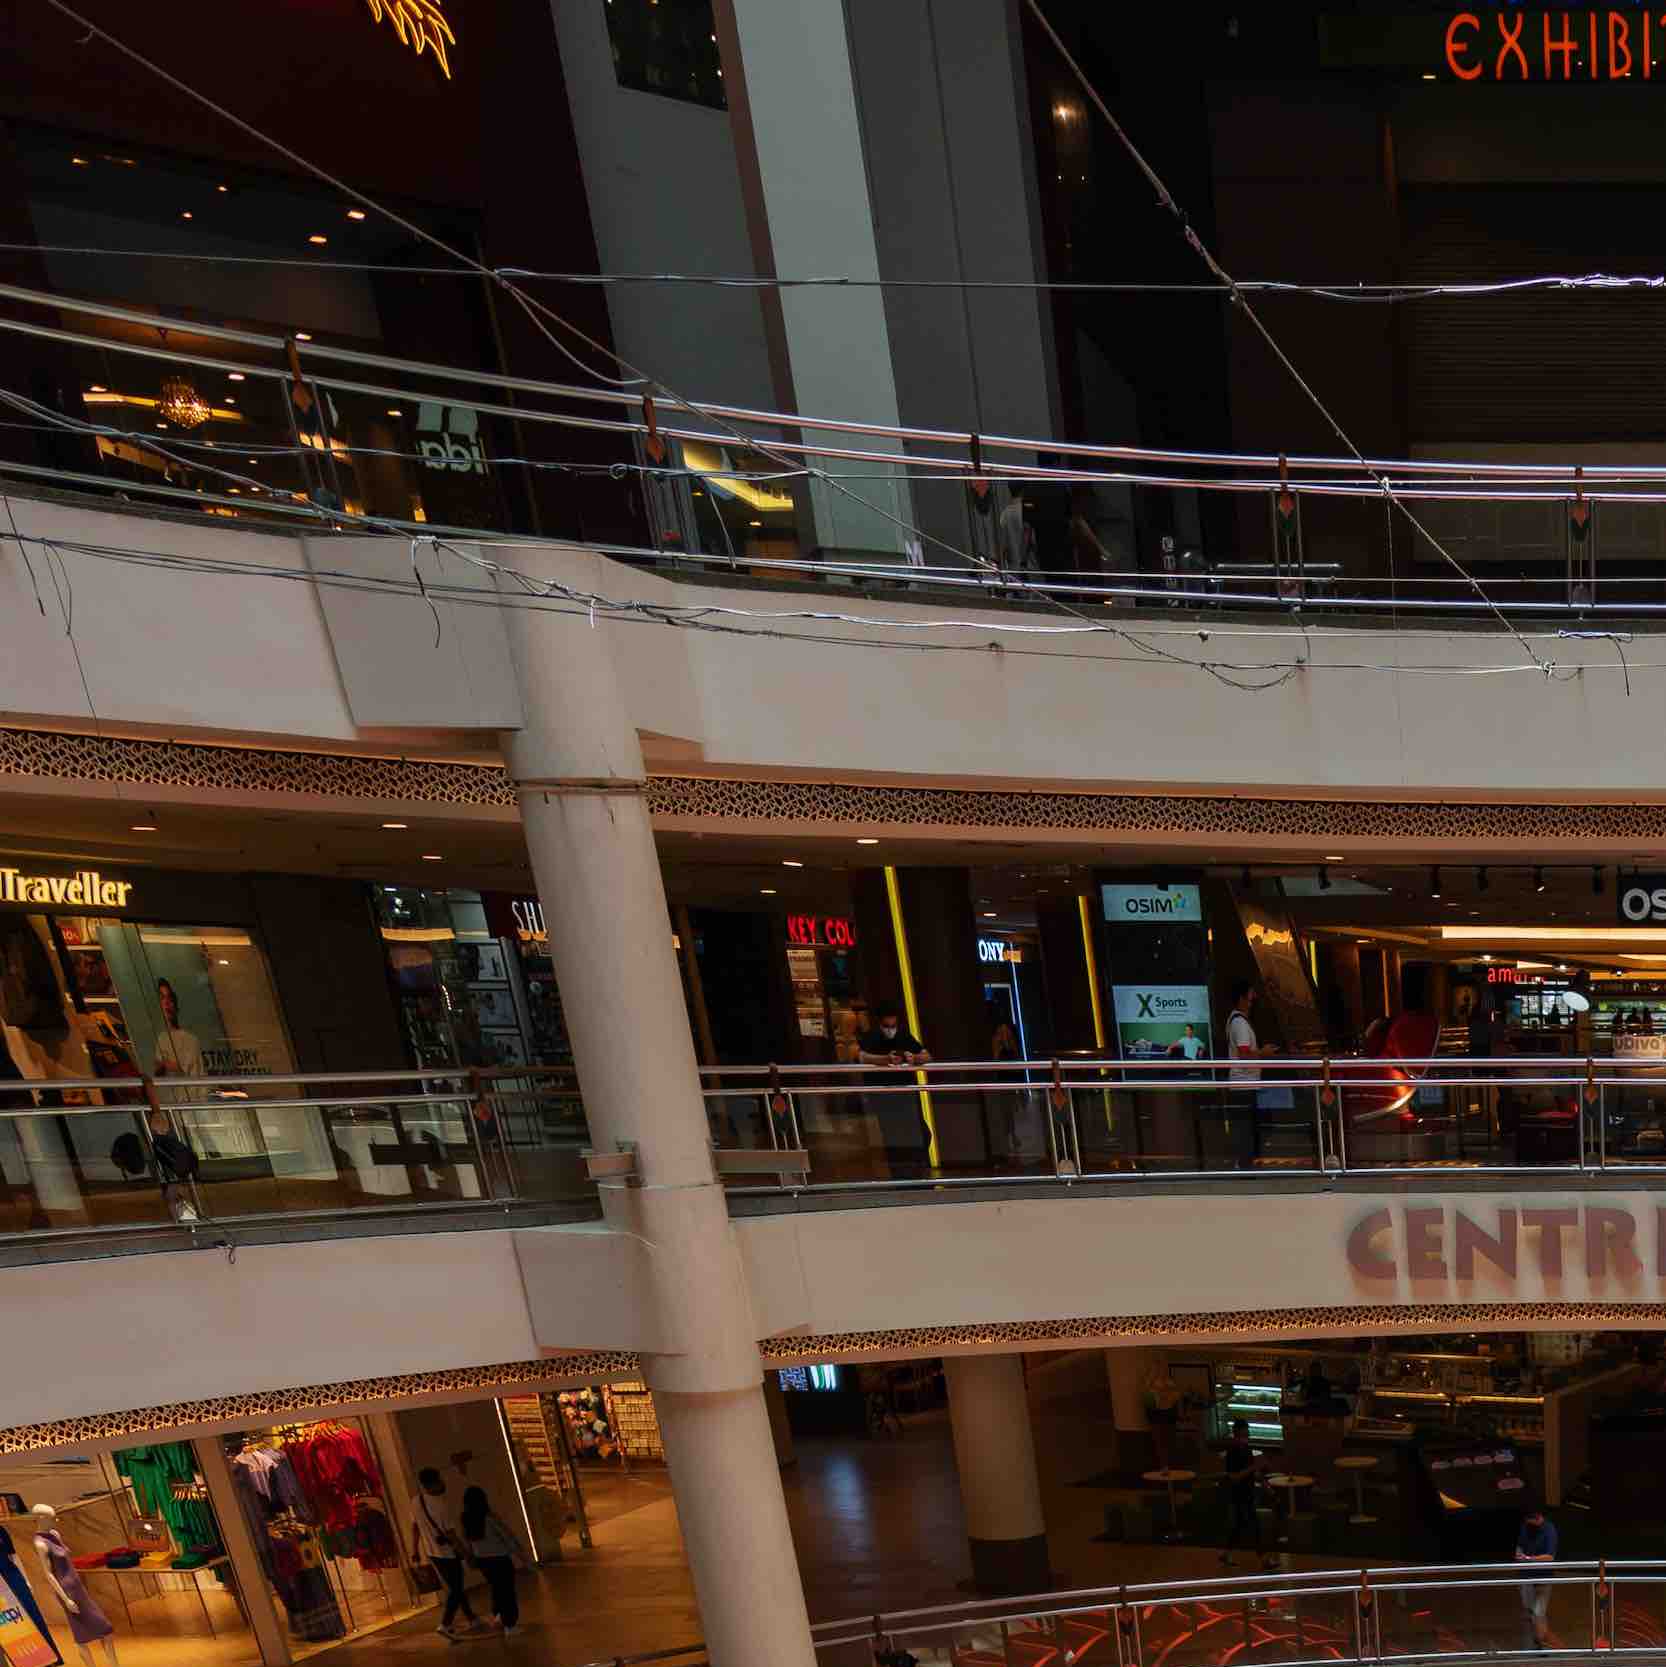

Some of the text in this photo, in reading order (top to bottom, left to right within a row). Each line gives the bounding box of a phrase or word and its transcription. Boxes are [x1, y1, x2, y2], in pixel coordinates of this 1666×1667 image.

[1125, 897, 1172, 916] OSIM
[787, 914, 817, 944] KEY
[978, 941, 1003, 963] ONY
[1136, 994, 1187, 1018] X Sports
